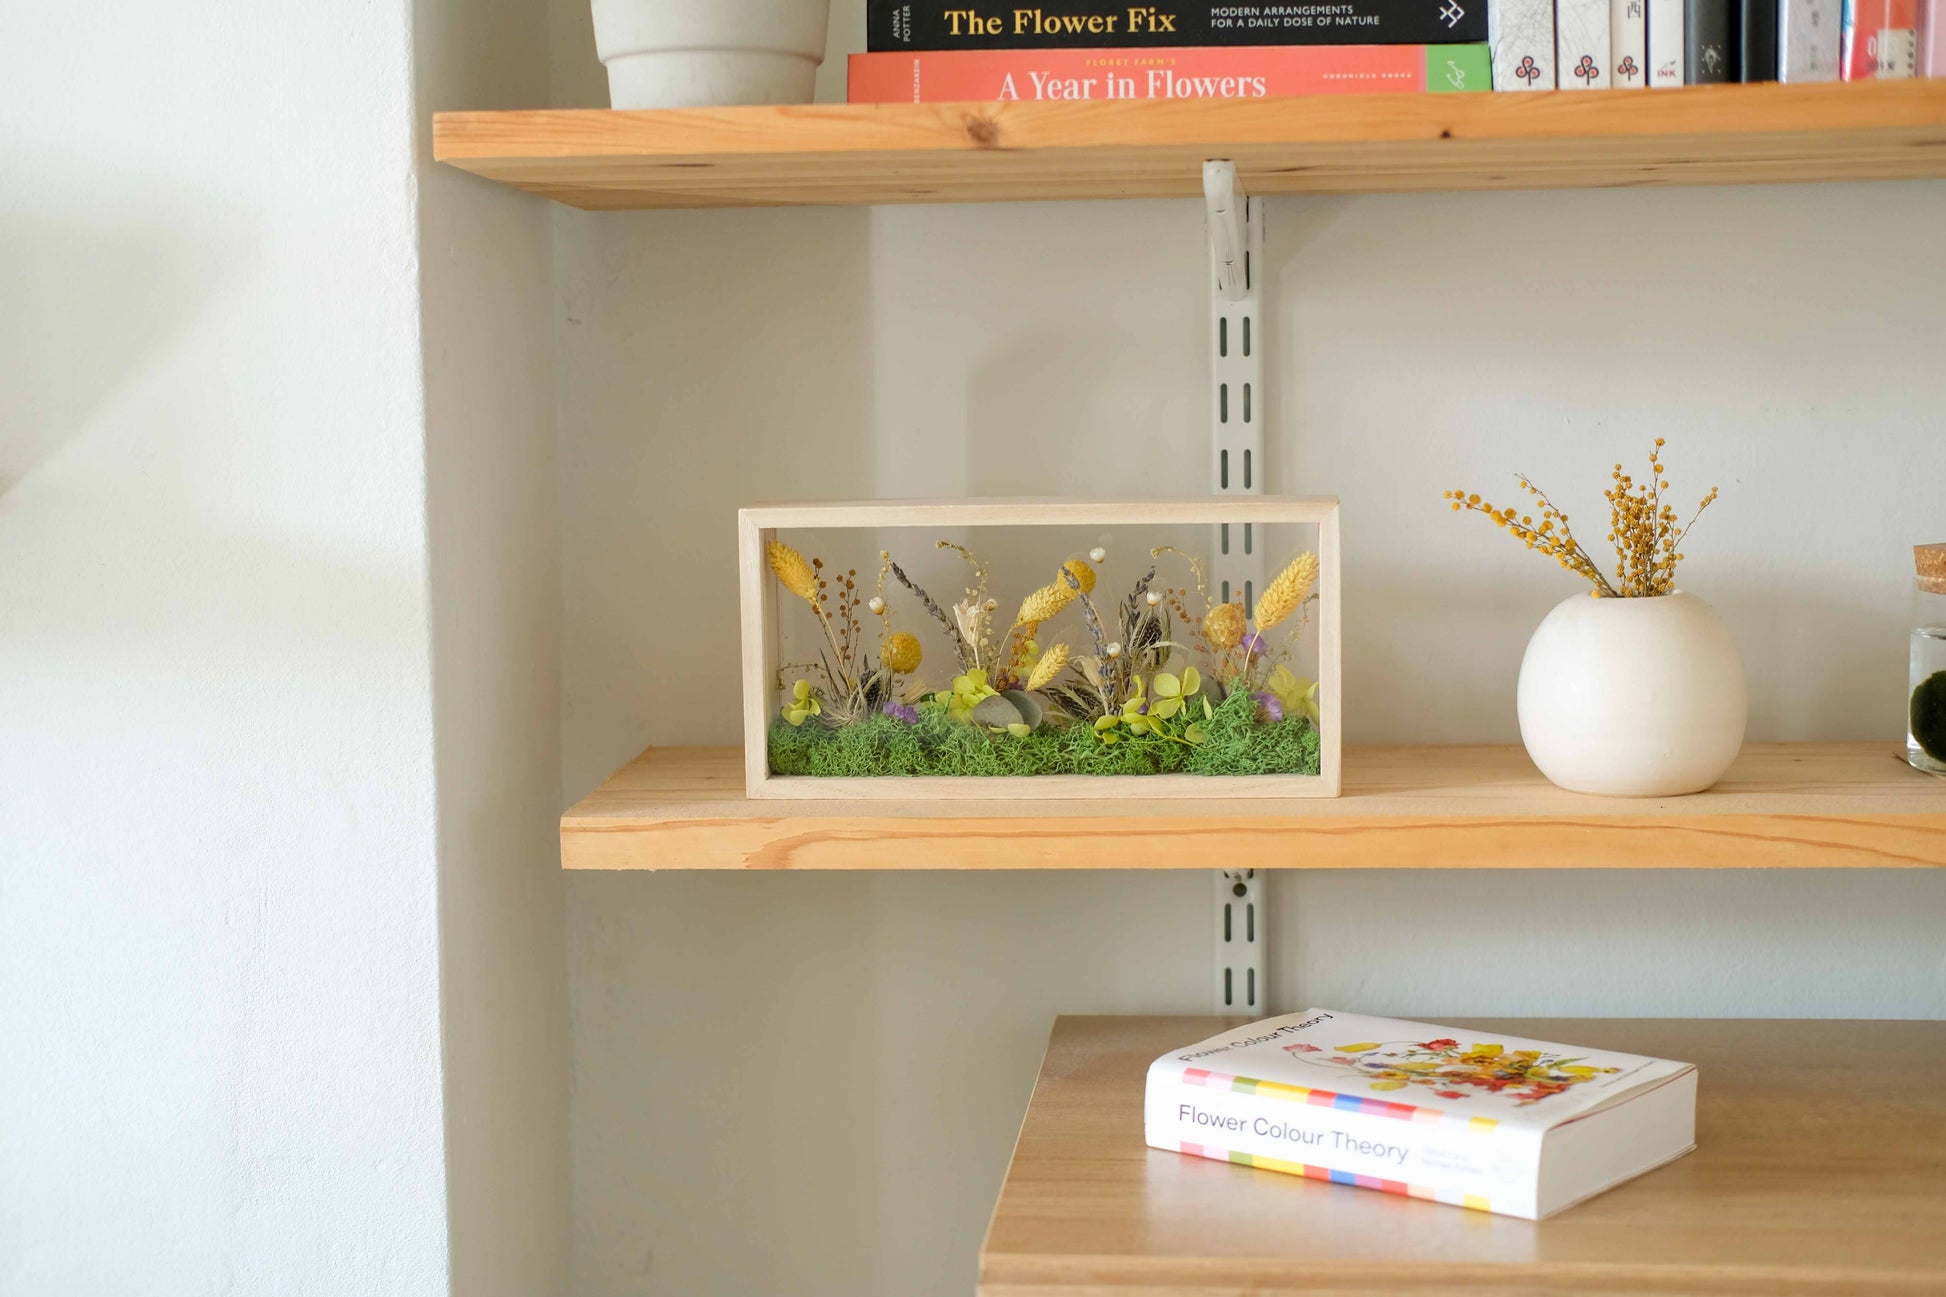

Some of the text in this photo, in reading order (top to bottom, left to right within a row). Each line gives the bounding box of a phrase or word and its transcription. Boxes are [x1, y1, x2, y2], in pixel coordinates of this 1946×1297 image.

[892, 8, 900, 39] ANNA
[903, 5, 911, 42] POTTER
[943, 7, 1177, 36] The Flower Fix
[1210, 5, 1353, 17] MODERN ARRANGEMENTS
[1211, 15, 1380, 28] FOR A DAILY DOSE OF NATURE
[1086, 57, 1177, 67] FLORET FARM'S
[1657, 69, 1676, 78] INK
[997, 69, 1267, 101] A Year in Flowers
[1178, 1013, 1334, 1062] Flower Colour Theory
[1178, 1103, 1247, 1132] Flower
[1253, 1117, 1324, 1146] Colour
[1331, 1130, 1409, 1165] Theory
